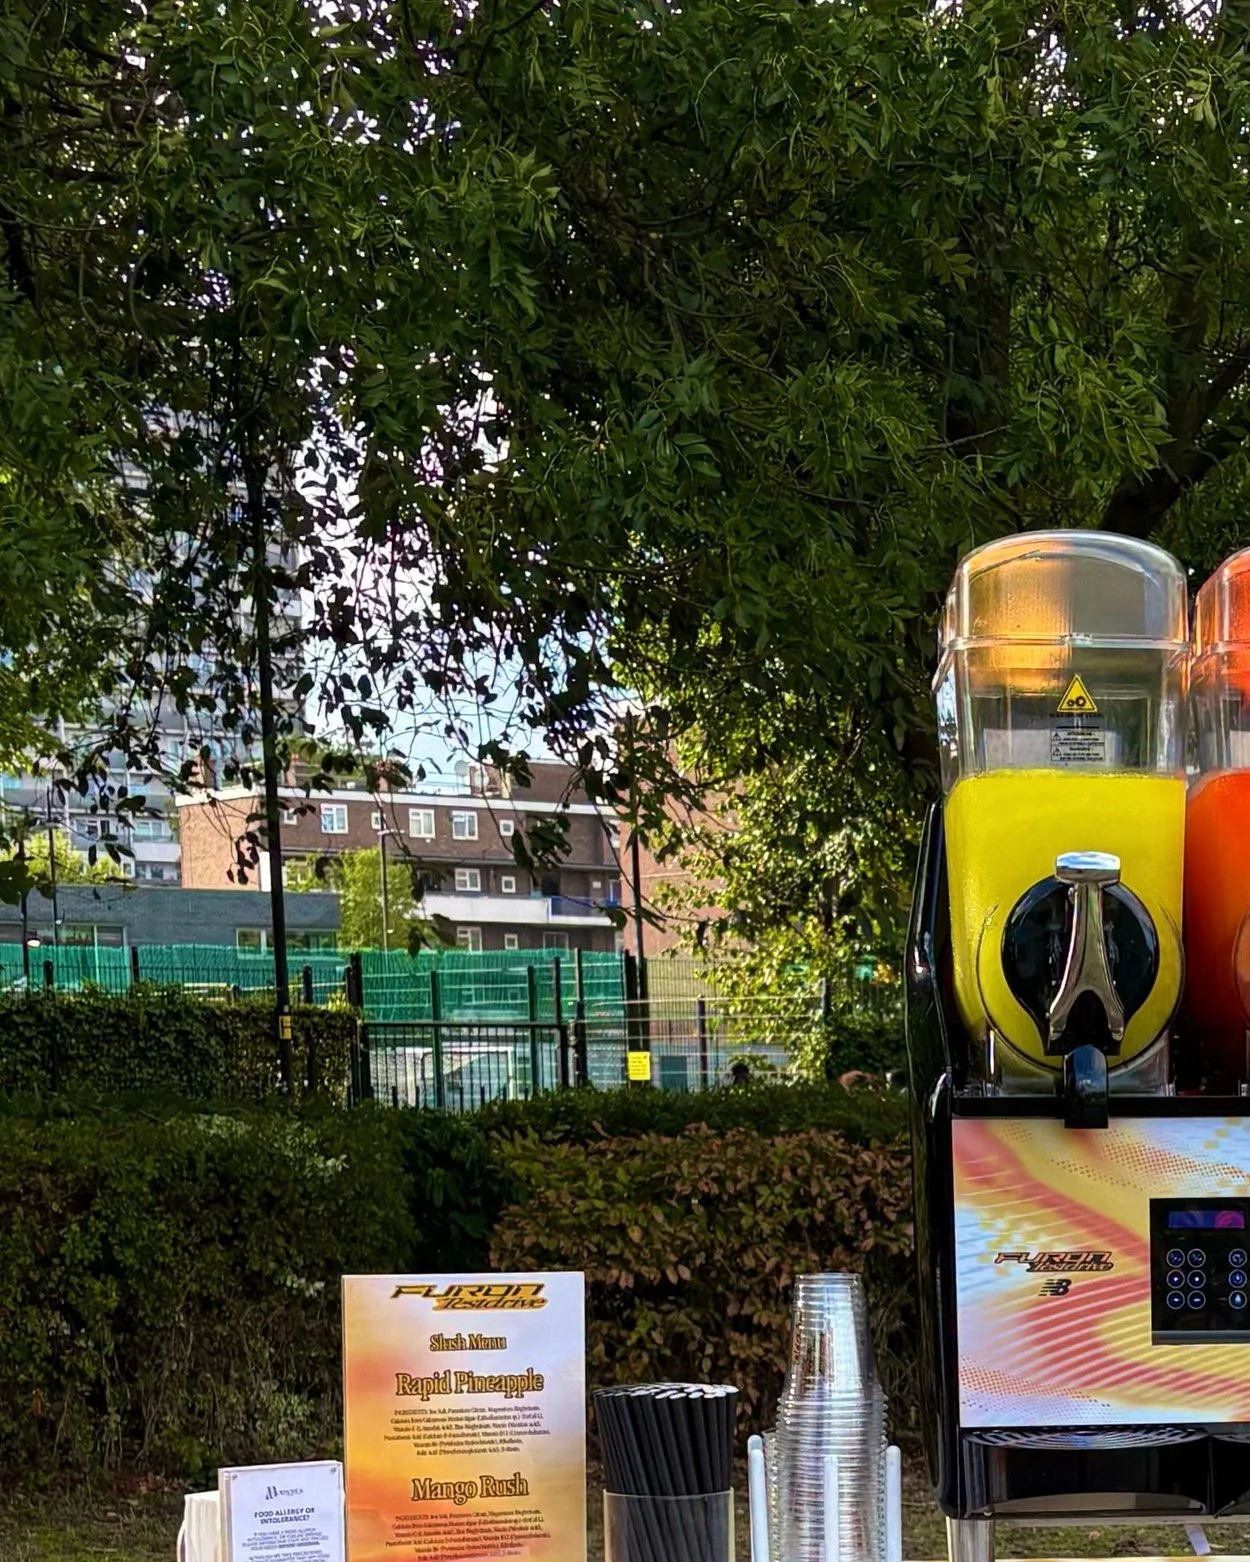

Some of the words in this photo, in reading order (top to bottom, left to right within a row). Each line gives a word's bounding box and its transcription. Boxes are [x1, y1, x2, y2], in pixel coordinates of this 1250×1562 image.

[994, 1251, 1112, 1264] FURON
[390, 1284, 545, 1299] FURON
[430, 1332, 467, 1351] Slush
[467, 1333, 508, 1350] Menu
[396, 1368, 452, 1401] Rapid
[454, 1367, 545, 1399] Pineapple
[411, 1477, 478, 1505] Mango
[479, 1471, 530, 1498] Rush
